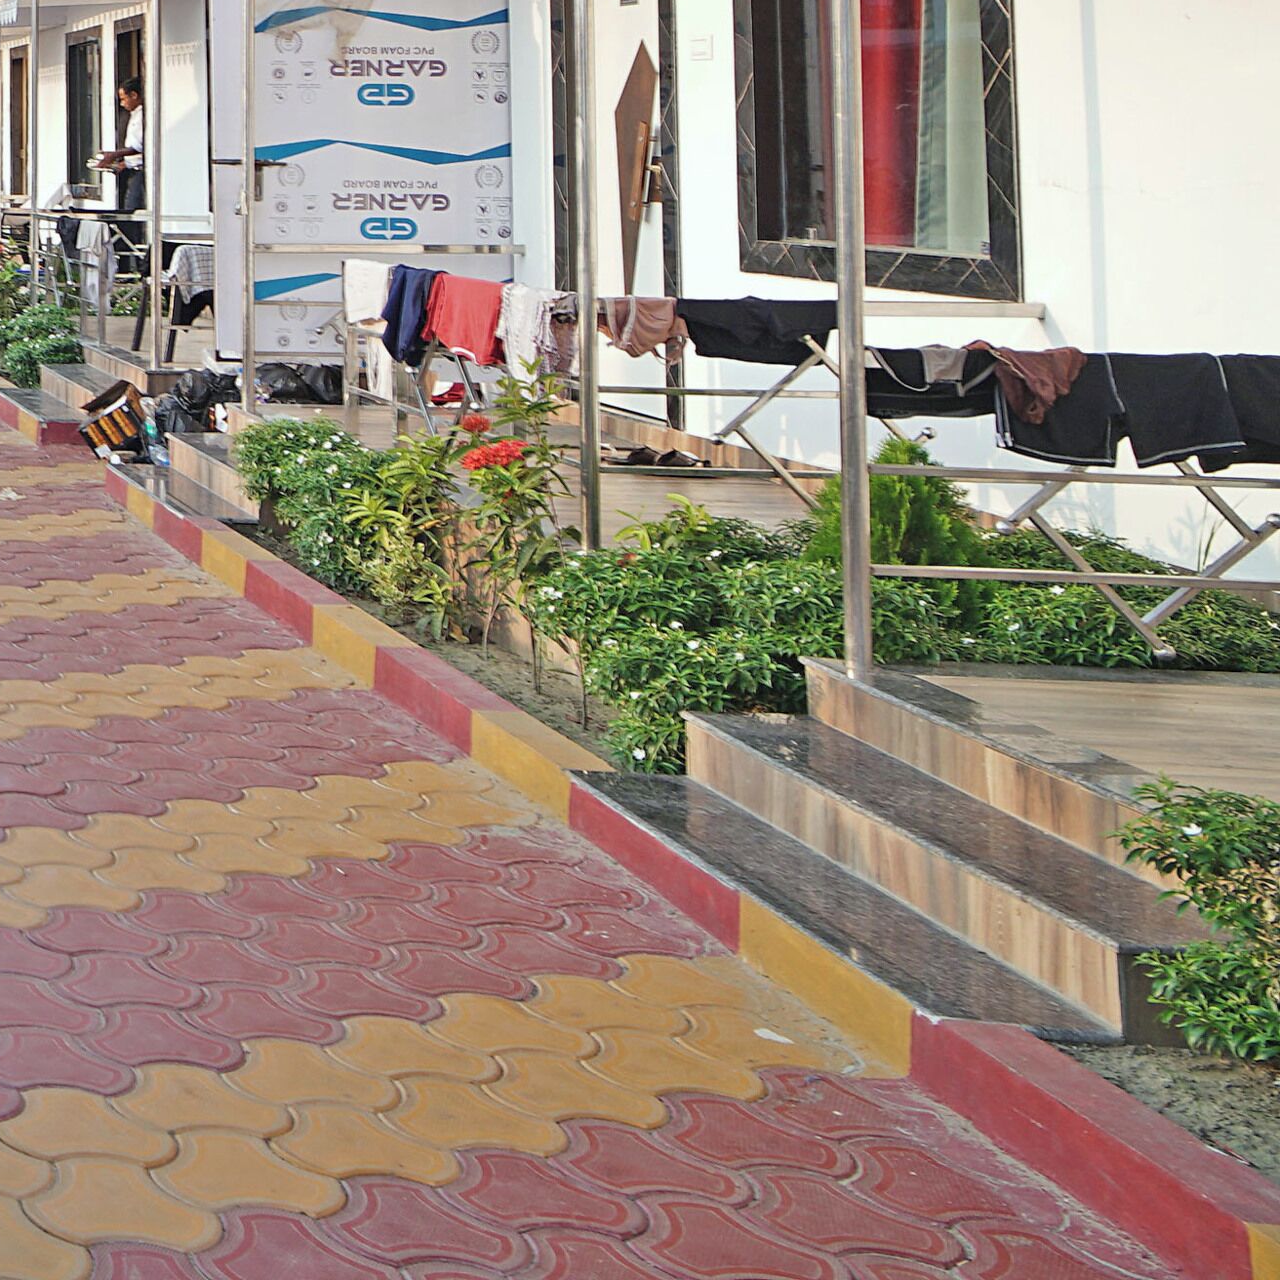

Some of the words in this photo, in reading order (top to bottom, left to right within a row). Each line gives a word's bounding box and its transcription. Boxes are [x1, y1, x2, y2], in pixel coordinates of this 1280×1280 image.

[381, 46, 411, 55] FOAM
[413, 46, 435, 55] PVC
[328, 59, 447, 77] GARNER
[343, 179, 381, 189] BOARD
[383, 180, 414, 189] FOAM
[416, 180, 438, 189] PVC
[331, 193, 450, 211] GARNER
